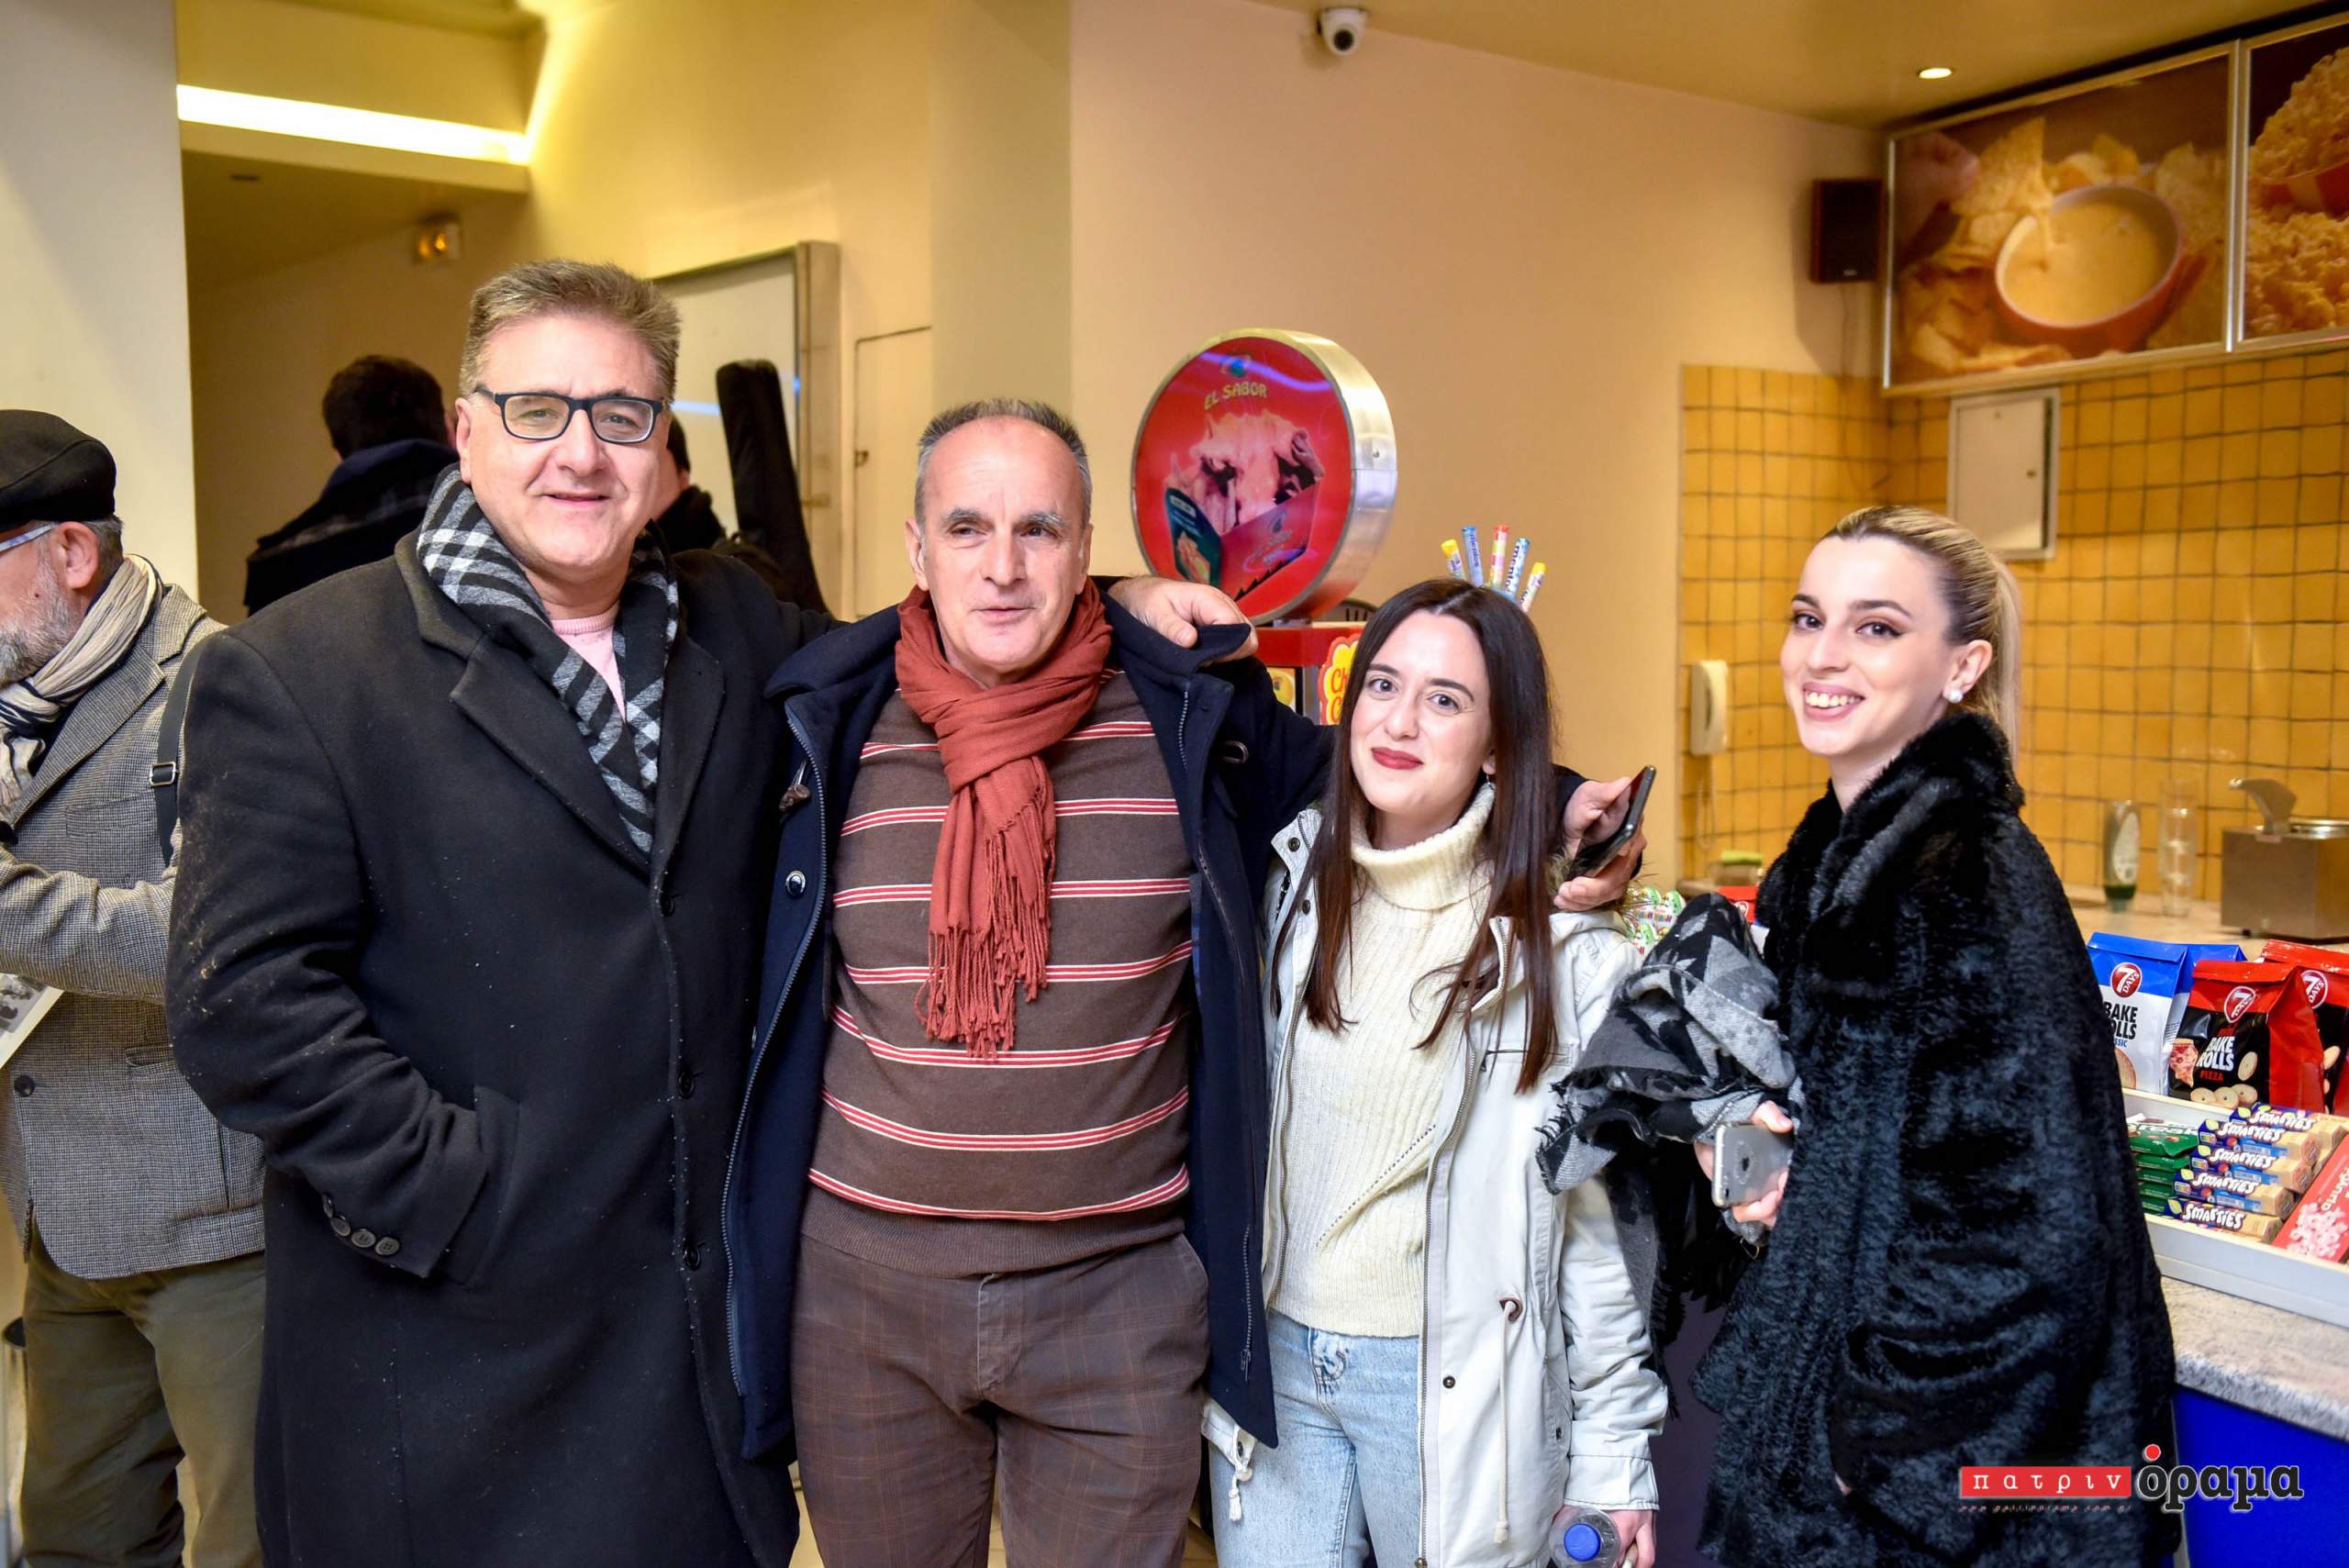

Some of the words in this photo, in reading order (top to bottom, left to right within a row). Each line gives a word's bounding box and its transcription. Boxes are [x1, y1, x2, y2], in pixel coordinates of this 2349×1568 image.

[1204, 390, 1219, 411] EL
[1222, 382, 1267, 399] SABOR
[2116, 967, 2136, 994] 7
[2122, 973, 2140, 993] DAYS
[2104, 1002, 2138, 1023] BAKE
[2232, 992, 2253, 1018] 7
[2111, 1018, 2137, 1040] OLLS
[2206, 1036, 2235, 1053] BAKE
[2196, 1051, 2234, 1071] ROLLS
[2199, 1070, 2223, 1082] PIZZA
